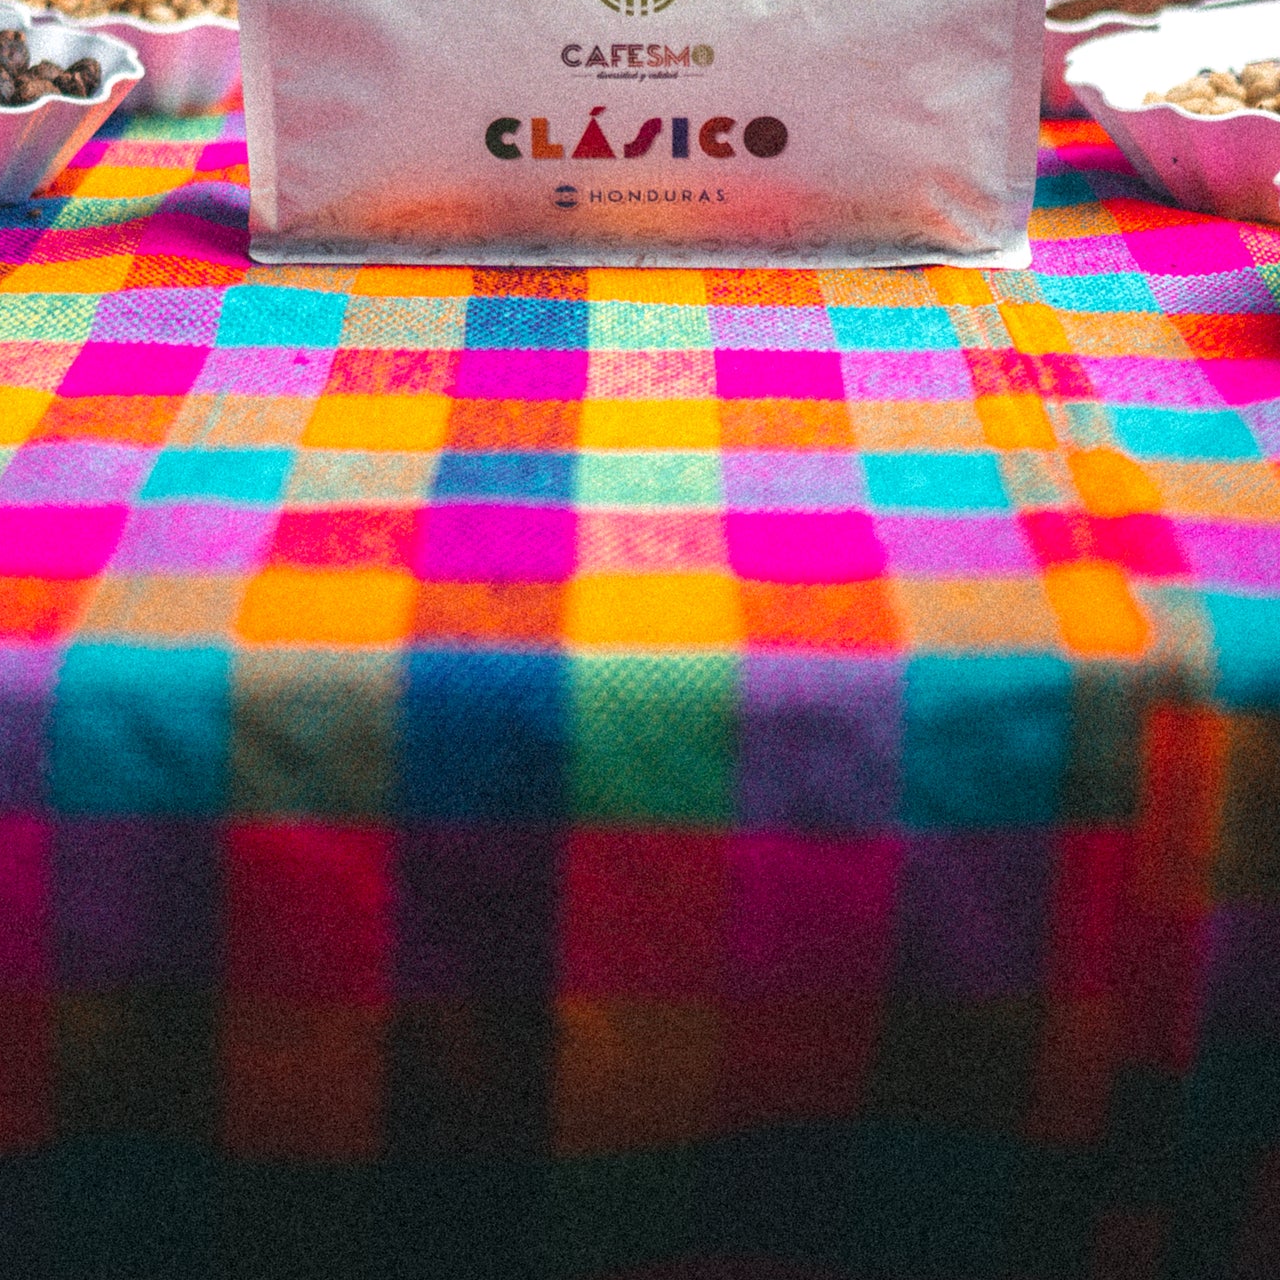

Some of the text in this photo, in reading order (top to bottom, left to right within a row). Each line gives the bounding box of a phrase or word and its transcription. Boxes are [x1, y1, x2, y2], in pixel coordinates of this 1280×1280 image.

[560, 43, 715, 68] CAFESMO
[485, 105, 788, 159] CLÁSICO
[589, 189, 725, 202] HONDURAS
